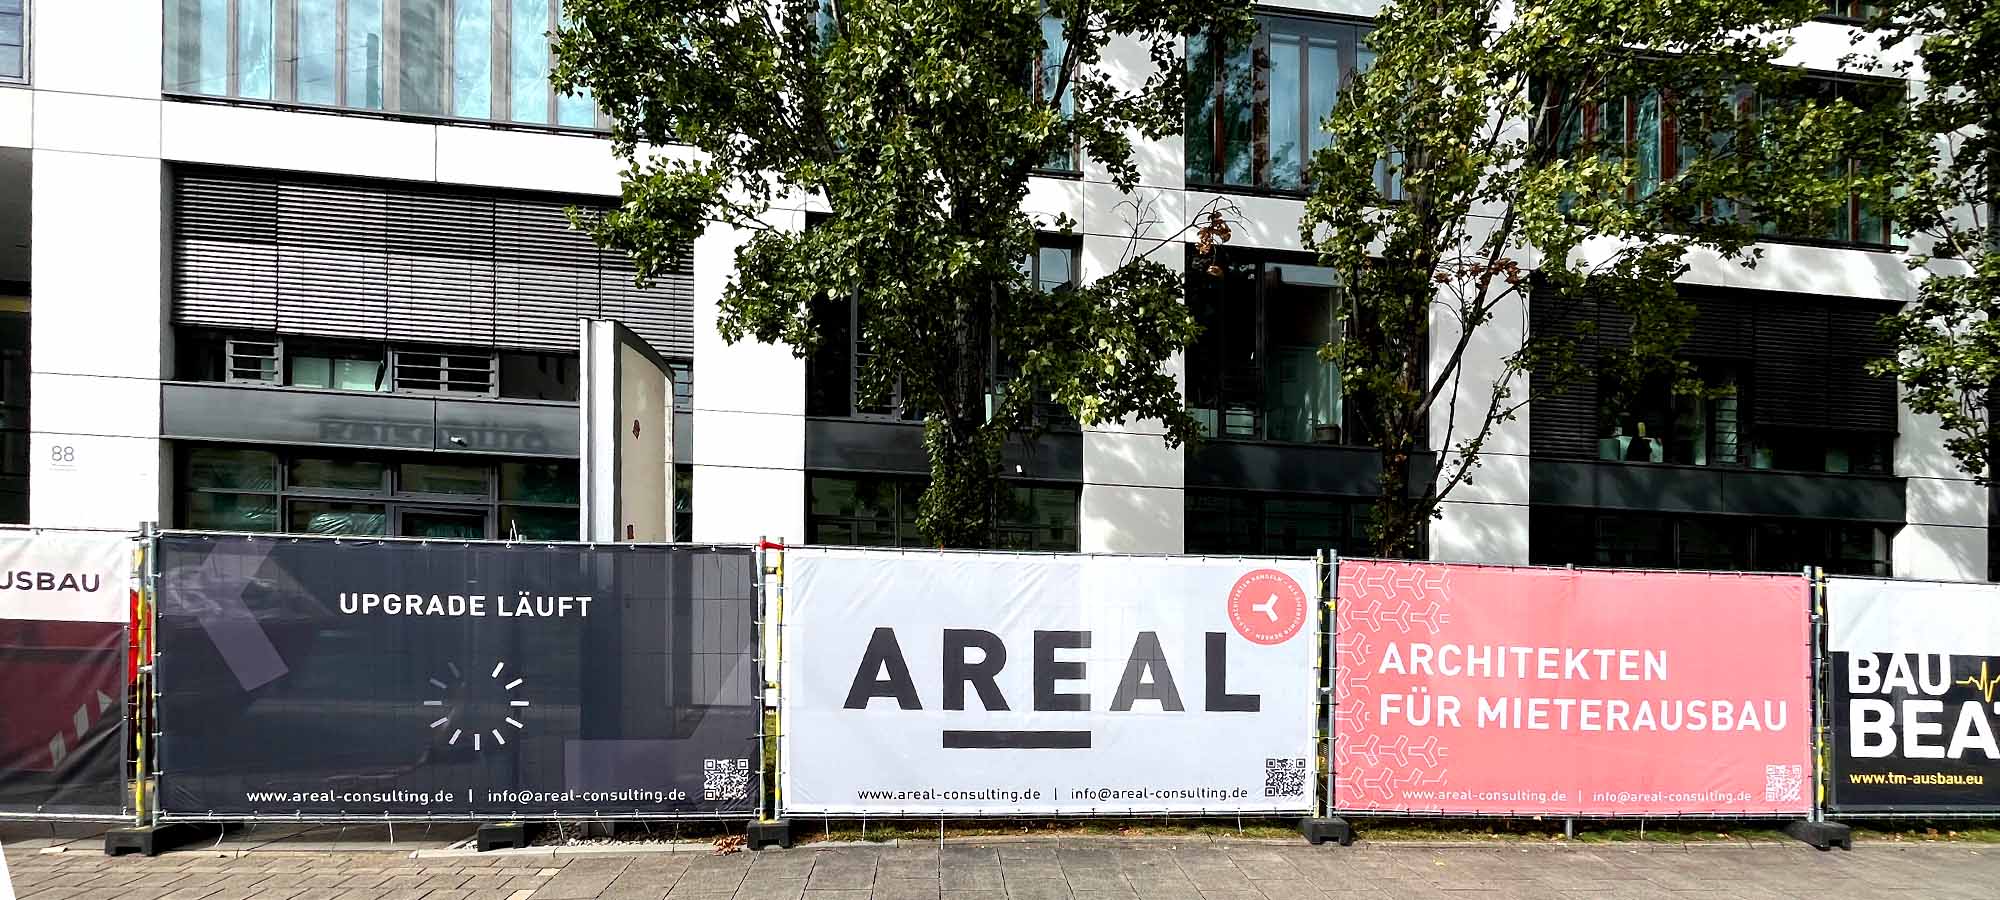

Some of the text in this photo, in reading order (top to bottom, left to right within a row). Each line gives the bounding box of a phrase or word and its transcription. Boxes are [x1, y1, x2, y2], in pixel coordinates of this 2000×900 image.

[52, 446, 74, 461] 88
[340, 591, 592, 617] UPGRADE LÄUFT
[843, 627, 1261, 712] AREAL
[1378, 642, 1668, 681] ARCHITEKTEN
[1849, 651, 1951, 695] BAU
[1379, 686, 1788, 732] FÜR MIETERAUSBAU
[1850, 698, 2000, 759] BEA
[1850, 772, 1984, 785] www.tm-ausbau.eu
[246, 789, 686, 805] www.areal-consulting.de info@areal-consulting.de
[857, 787, 1248, 802] www.areal-consulting.de info@areal-consulting.de
[1402, 789, 1752, 804] www.areal-consulting.de info@areal-consulting.de
